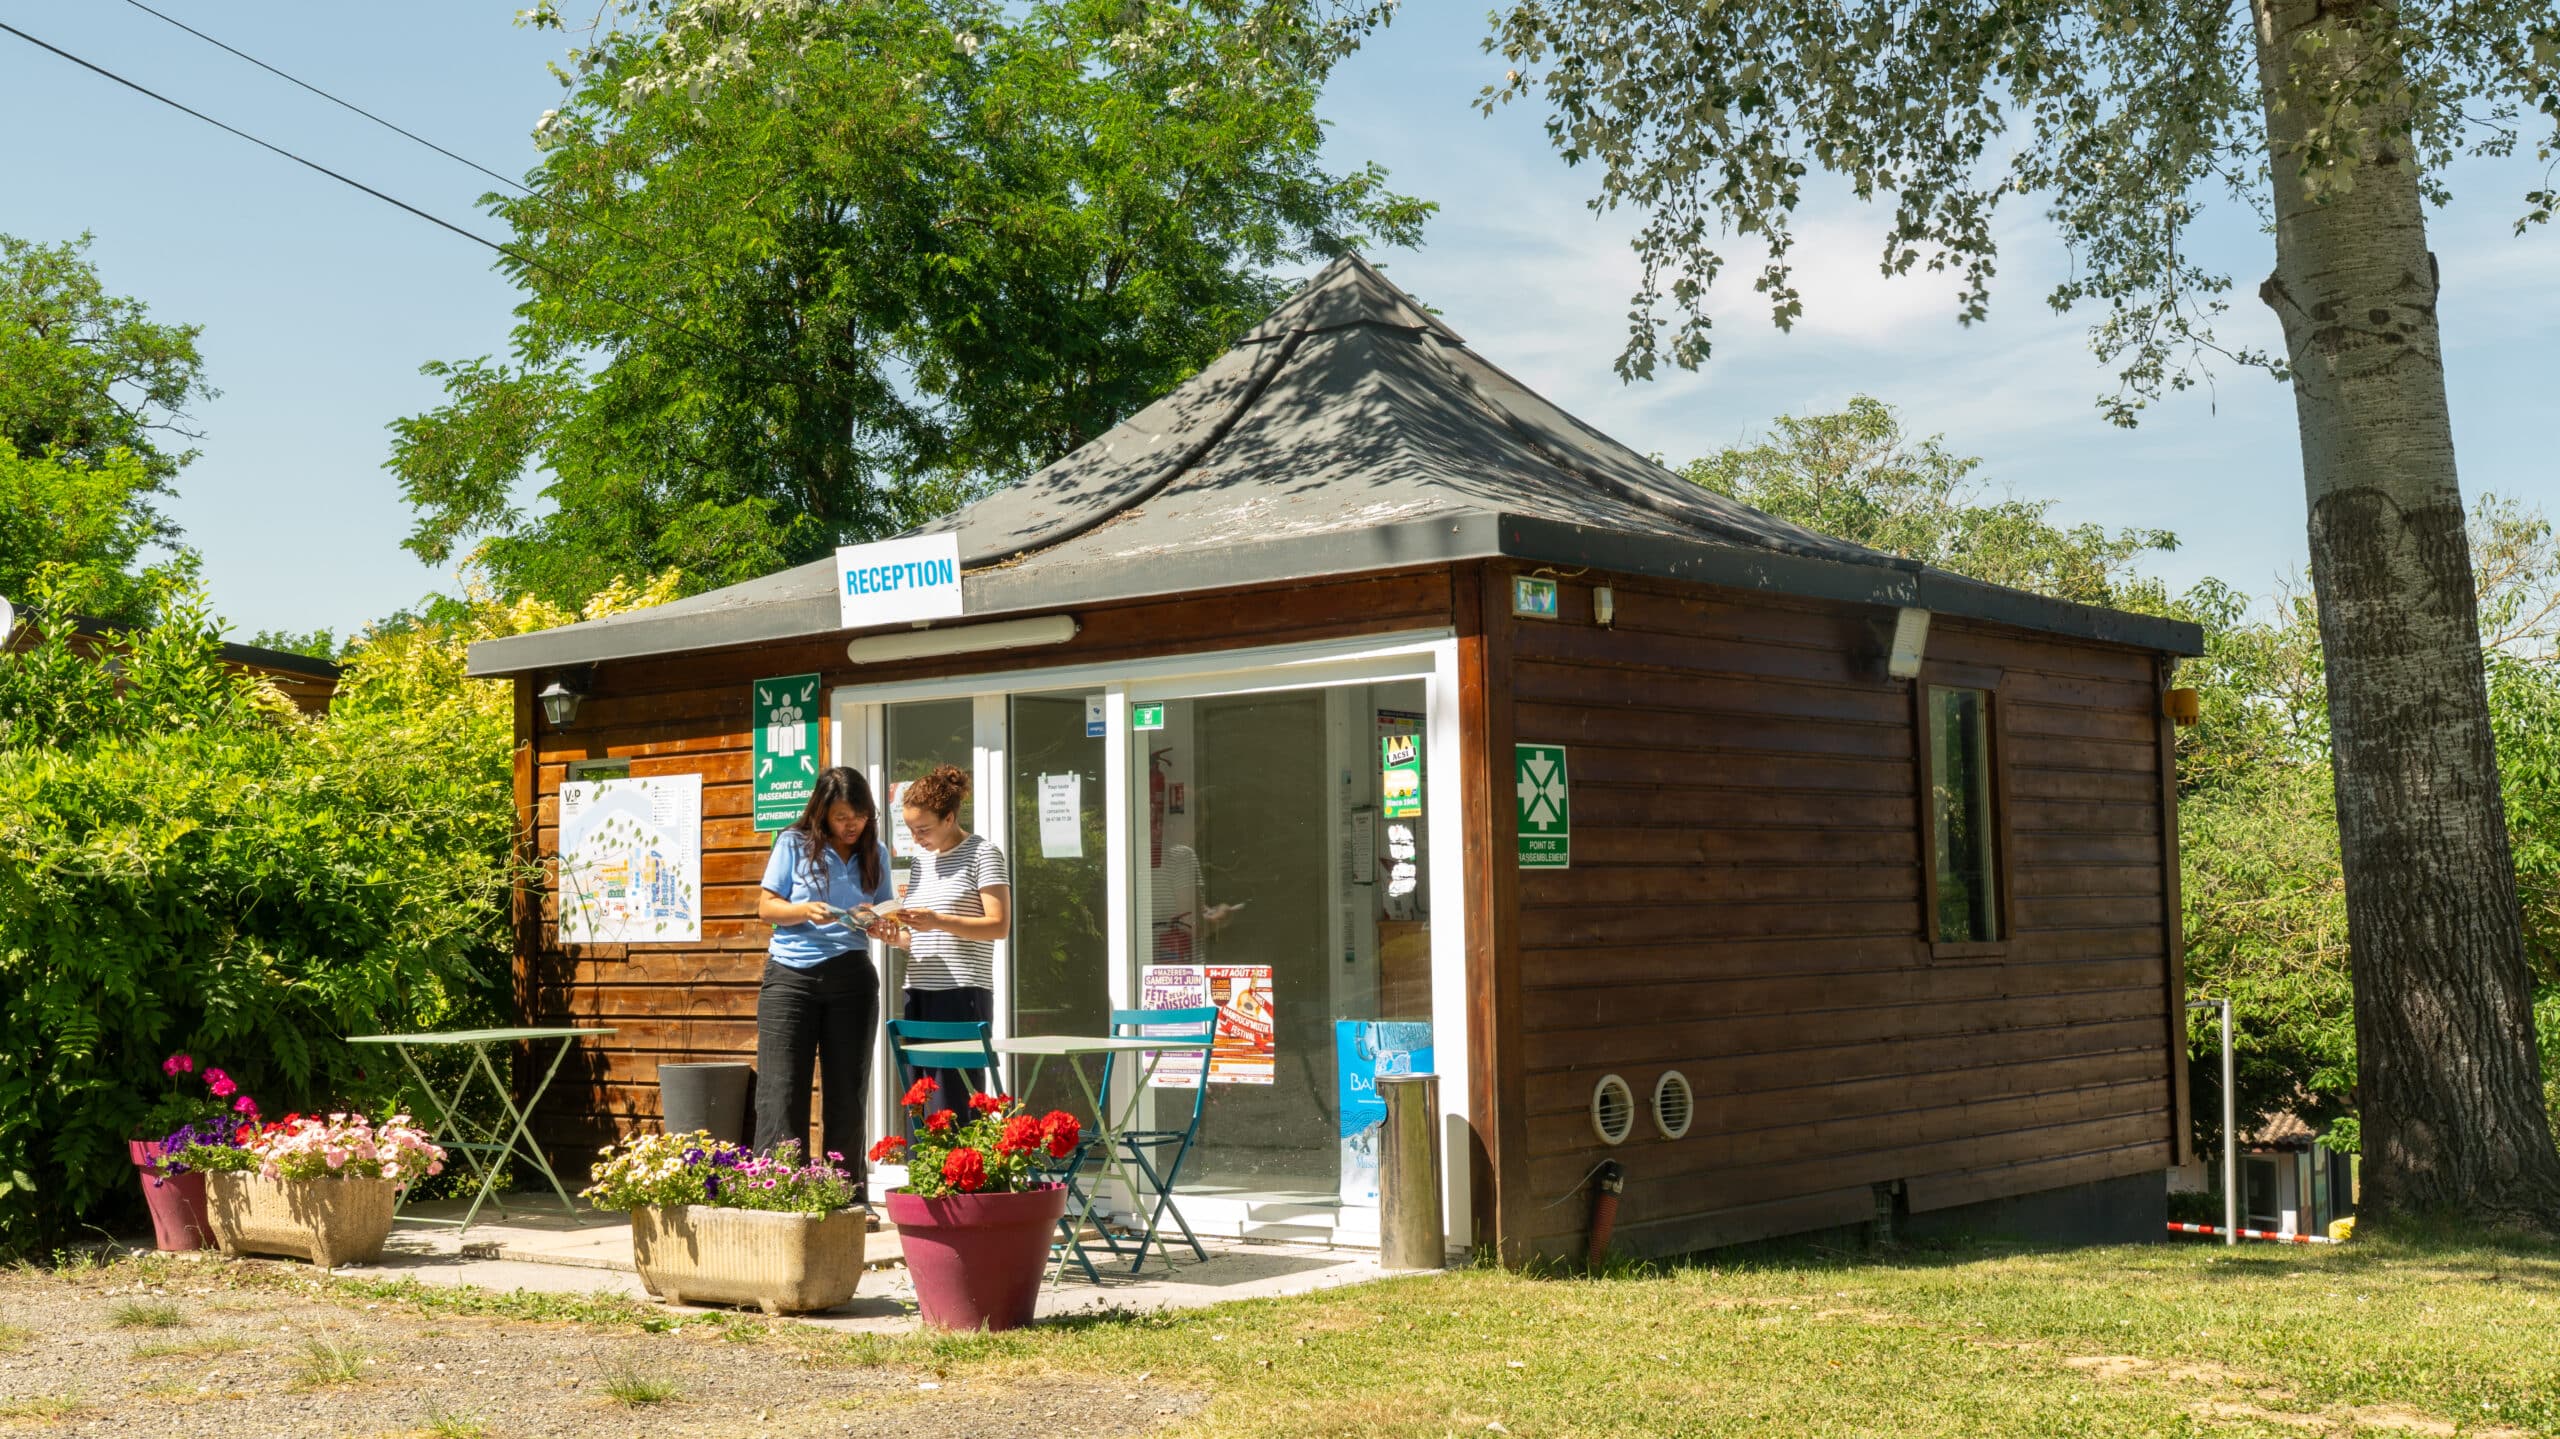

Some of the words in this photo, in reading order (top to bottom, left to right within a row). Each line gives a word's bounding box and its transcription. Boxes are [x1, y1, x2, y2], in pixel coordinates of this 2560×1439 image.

[846, 558, 953, 596] RECEPTION
[770, 781, 792, 791] POINT
[792, 780, 804, 789] DE
[757, 790, 815, 801] RASSEMBLEMEN
[757, 810, 796, 822] GATHERING
[1529, 840, 1546, 850] POINT
[1547, 840, 1556, 850] DE
[1145, 975, 1173, 985] SAMEDI
[1173, 975, 1183, 985] 21
[1184, 975, 1202, 985] JUIN
[1157, 993, 1203, 1010] MUSIQUE
[1231, 1025, 1256, 1042] FESTIVAL
